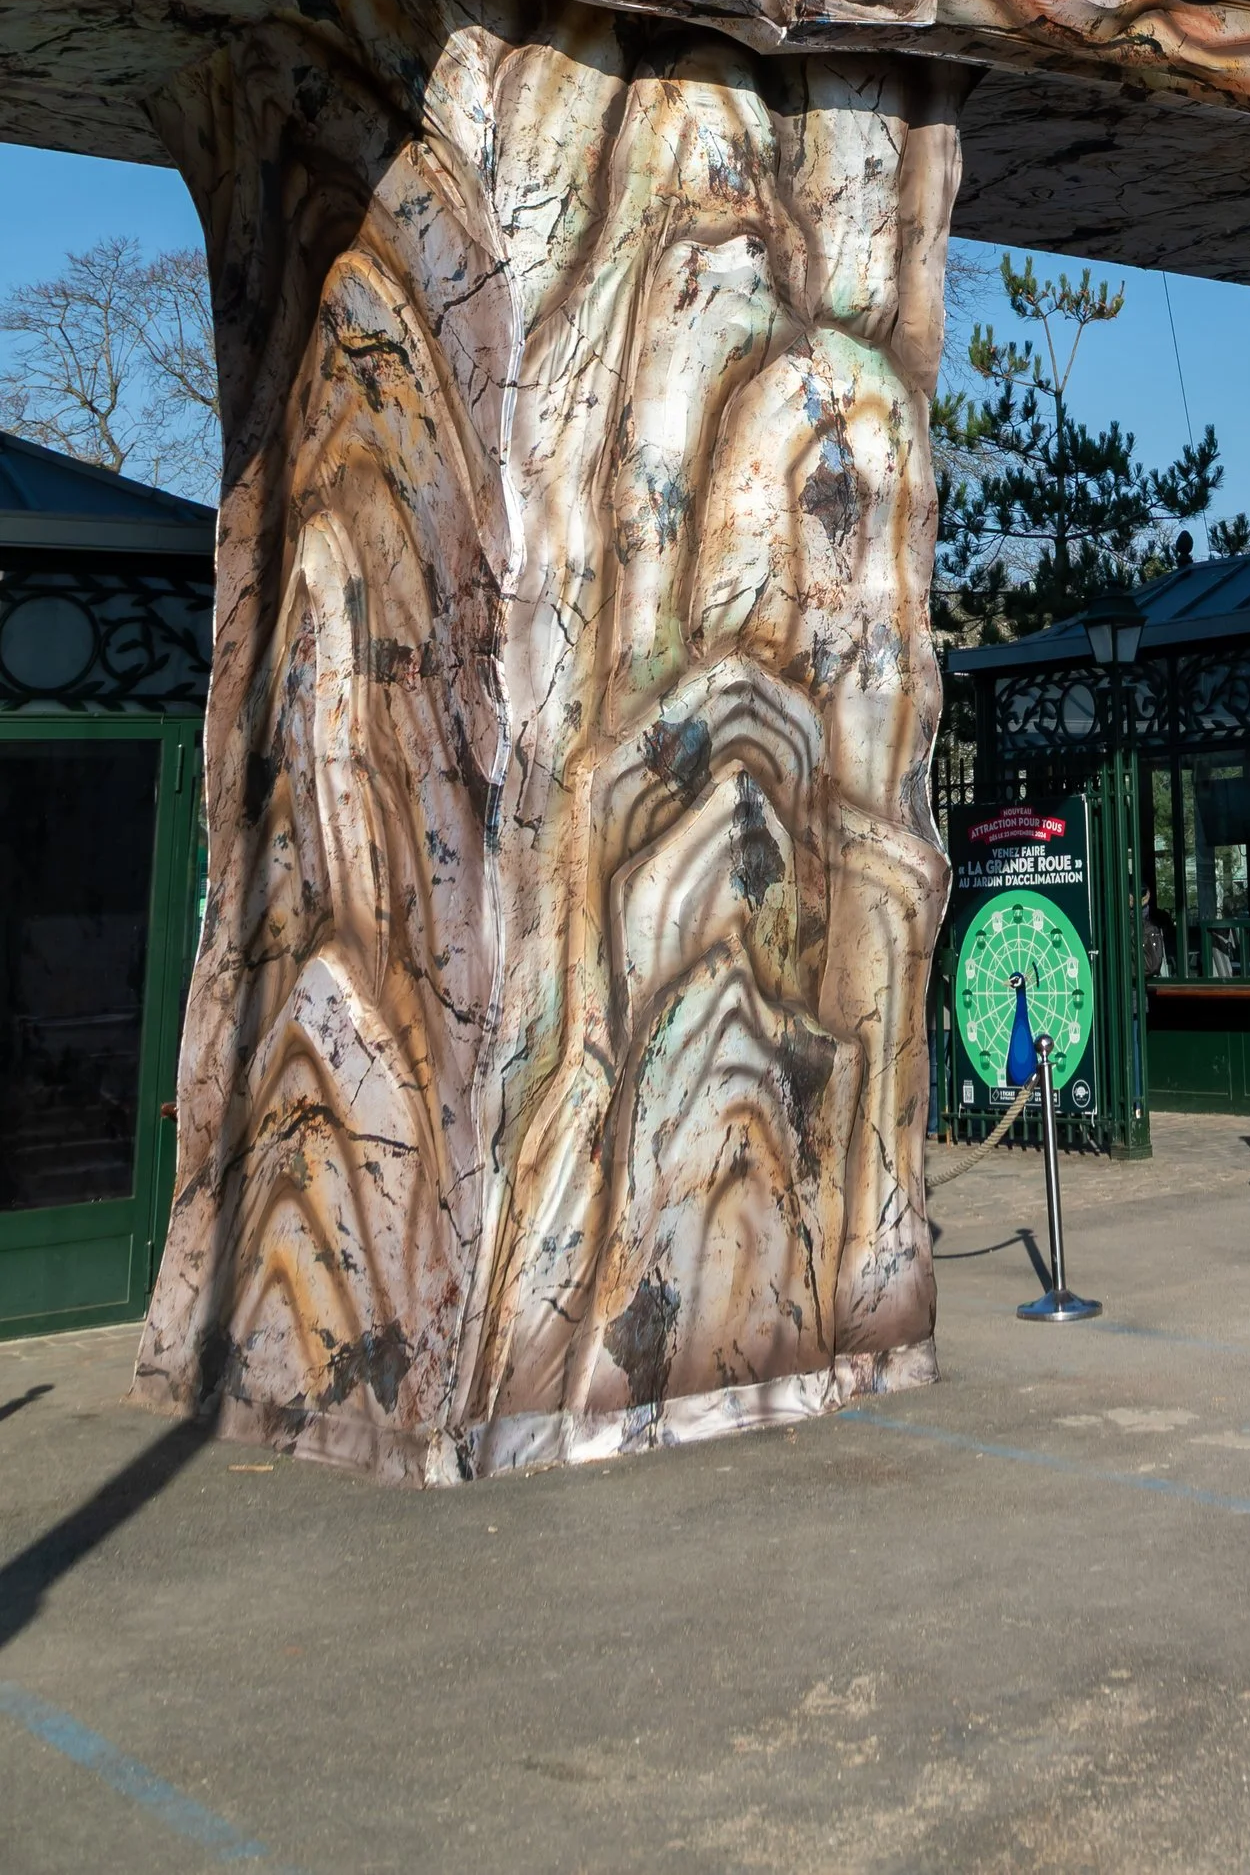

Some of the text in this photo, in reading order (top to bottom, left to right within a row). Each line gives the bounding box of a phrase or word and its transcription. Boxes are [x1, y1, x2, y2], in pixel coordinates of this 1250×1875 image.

[1003, 808, 1032, 816] NOUVEAU
[971, 817, 1063, 839] ATTRACTION POUR TOUS
[992, 845, 1046, 858] VENEZ FAIRE
[968, 861, 983, 876] LA
[986, 858, 1035, 874] GRANDE
[1037, 855, 1072, 872] ROUE
[959, 871, 1083, 888] AU JARDIN D'ACCLIMATATION
